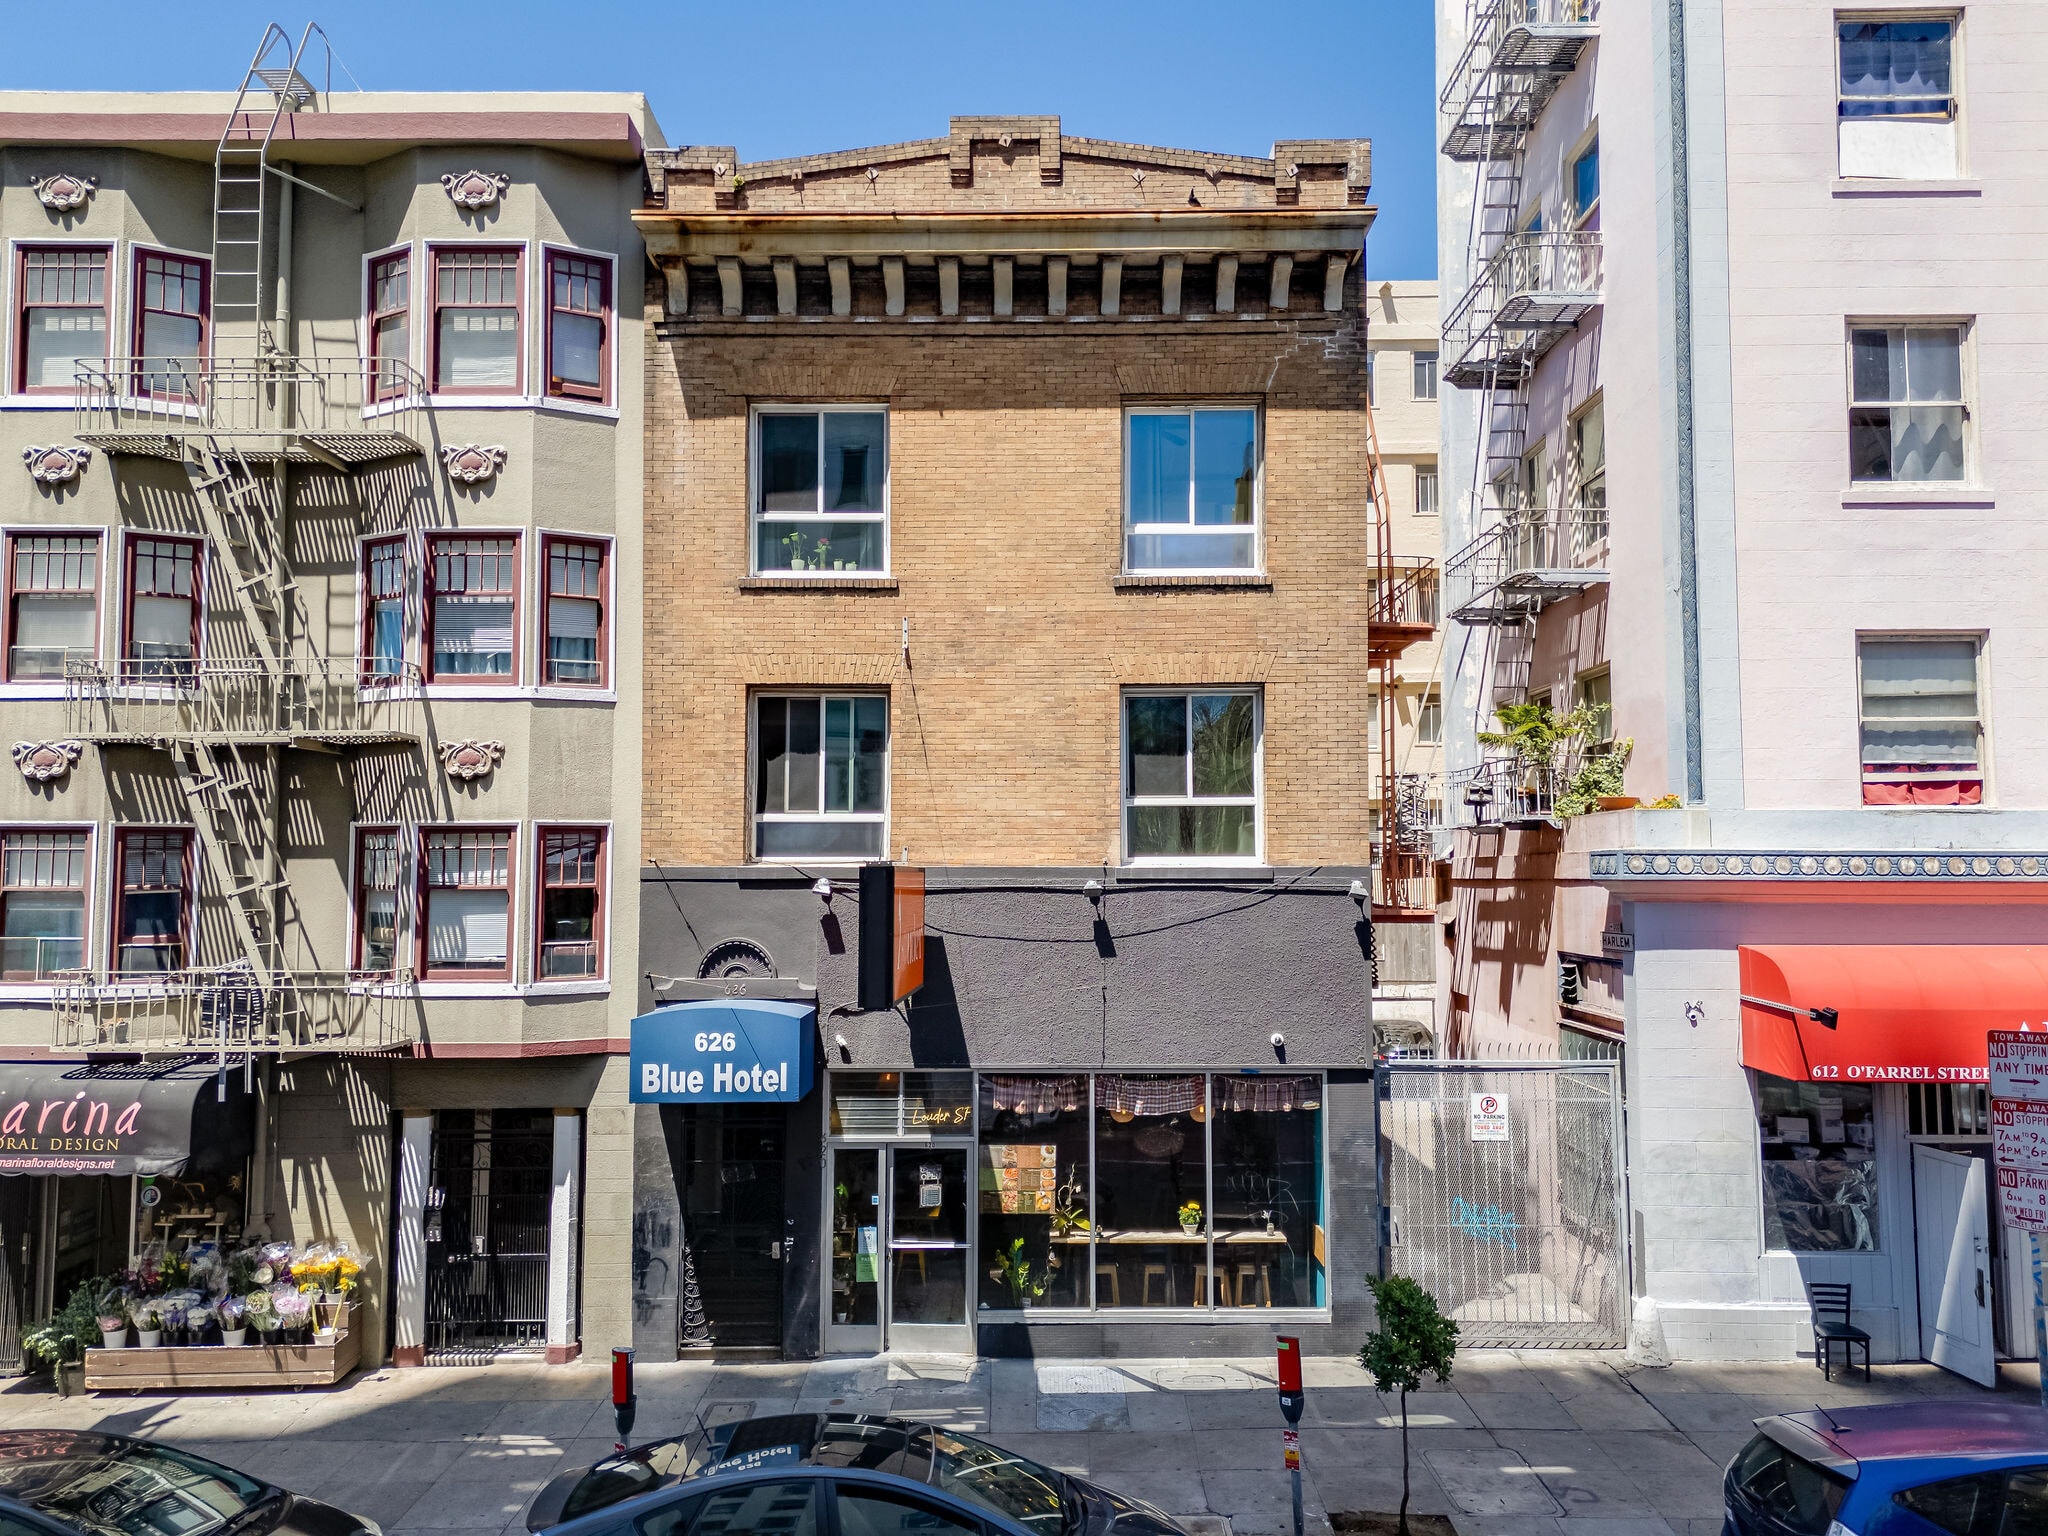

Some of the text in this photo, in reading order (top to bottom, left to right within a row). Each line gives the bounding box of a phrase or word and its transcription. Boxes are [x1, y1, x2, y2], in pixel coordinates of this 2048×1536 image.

[1603, 936, 1630, 948] HARLEM
[724, 983, 747, 996] 626
[694, 1032, 736, 1052] 626
[1993, 1032, 2048, 1043] TOW-AWAY
[1989, 1042, 2048, 1058] NO STOPPIN
[1812, 1065, 1990, 1080] 612 O'FARREL STREE
[1995, 1061, 2048, 1076] ANY TIME
[641, 1062, 788, 1094] Blue Hotel
[0, 1091, 142, 1136] arina
[1998, 1101, 2017, 1110] TOW
[2026, 1104, 2048, 1113] AWA
[912, 1107, 950, 1125] Louder
[1993, 1110, 2048, 1127] NO STOPPI
[0, 1137, 119, 1151] RAL DESIGN
[2000, 1170, 2048, 1191] NO PARKI
[2006, 1190, 2022, 1202] 6AM
[2004, 1204, 2046, 1220] MON WED FRI
[2008, 1219, 2048, 1231] STREET CLEA
